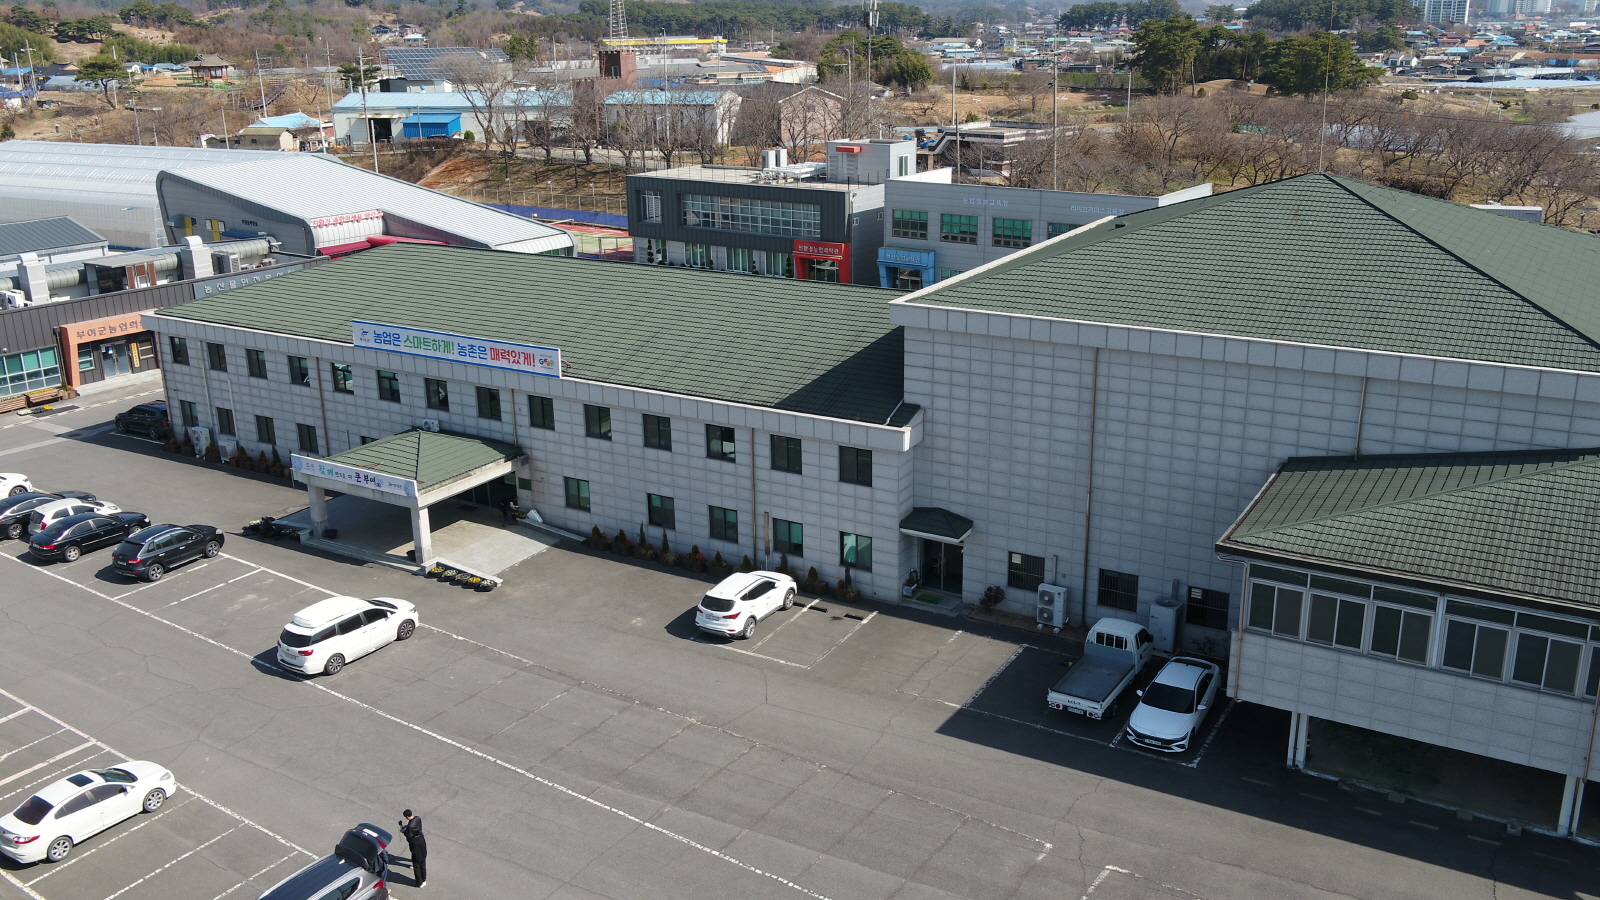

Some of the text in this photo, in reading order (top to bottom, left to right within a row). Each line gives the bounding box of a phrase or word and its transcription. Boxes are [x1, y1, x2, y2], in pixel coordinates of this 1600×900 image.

[962, 197, 1009, 207] 농업정보교육장
[1070, 205, 1125, 215] 라이브커머스교육장
[76, 319, 142, 339] 부여군농업회
[373, 329, 402, 347] 농업은
[403, 334, 455, 355] 스마트하게!
[457, 342, 488, 361] 농촌은
[489, 346, 536, 367] 매력있게!
[354, 472, 362, 483] 큰
